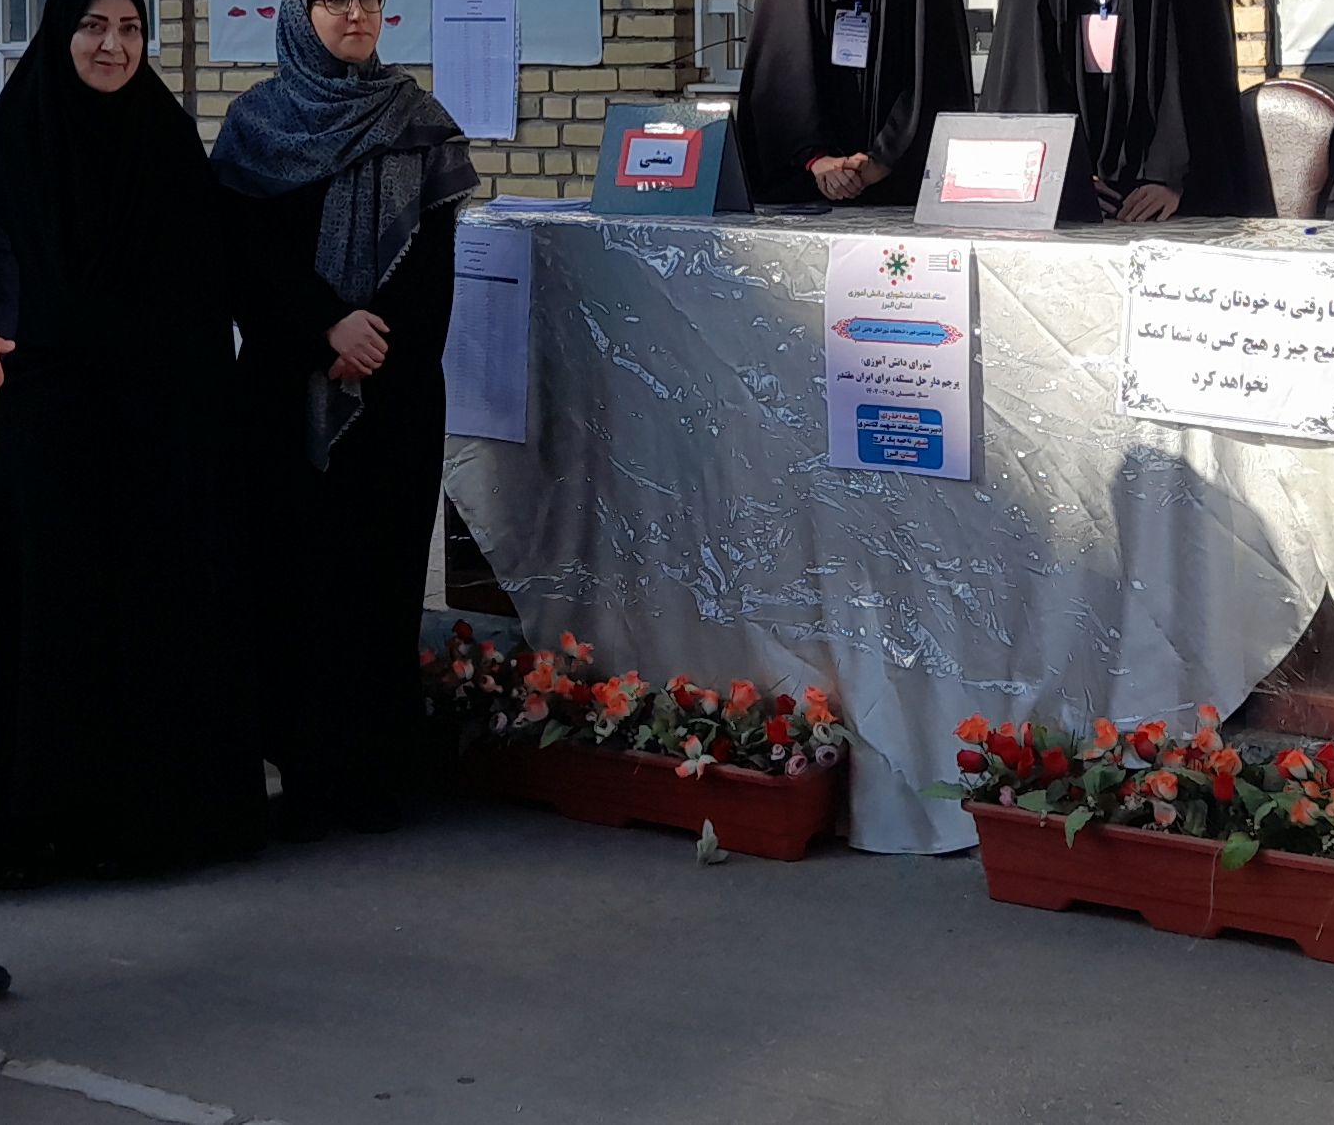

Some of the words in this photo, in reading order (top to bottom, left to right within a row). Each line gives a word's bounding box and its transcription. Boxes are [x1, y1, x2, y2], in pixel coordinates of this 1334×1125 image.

[639, 149, 673, 168] منشی
[1185, 286, 1217, 304] کمک
[1220, 289, 1269, 314] خودتان
[1274, 298, 1286, 317] به
[1290, 296, 1324, 322] وقتی
[1138, 322, 1168, 339] کمک
[1171, 326, 1192, 342] شما
[1195, 331, 1208, 349] به
[1211, 331, 1239, 351] کس
[1241, 336, 1268, 355] هیچ
[1271, 342, 1280, 358] و
[1284, 340, 1309, 362] چیز
[888, 357, 907, 368] دانش
[908, 359, 932, 371] شورای
[836, 371, 855, 381] مقتدر
[855, 372, 874, 384] ایران
[874, 373, 891, 386] برای
[915, 376, 927, 387] حل
[929, 376, 941, 388] دار
[1191, 370, 1217, 391] کرد
[1220, 372, 1269, 397] نخواهد
